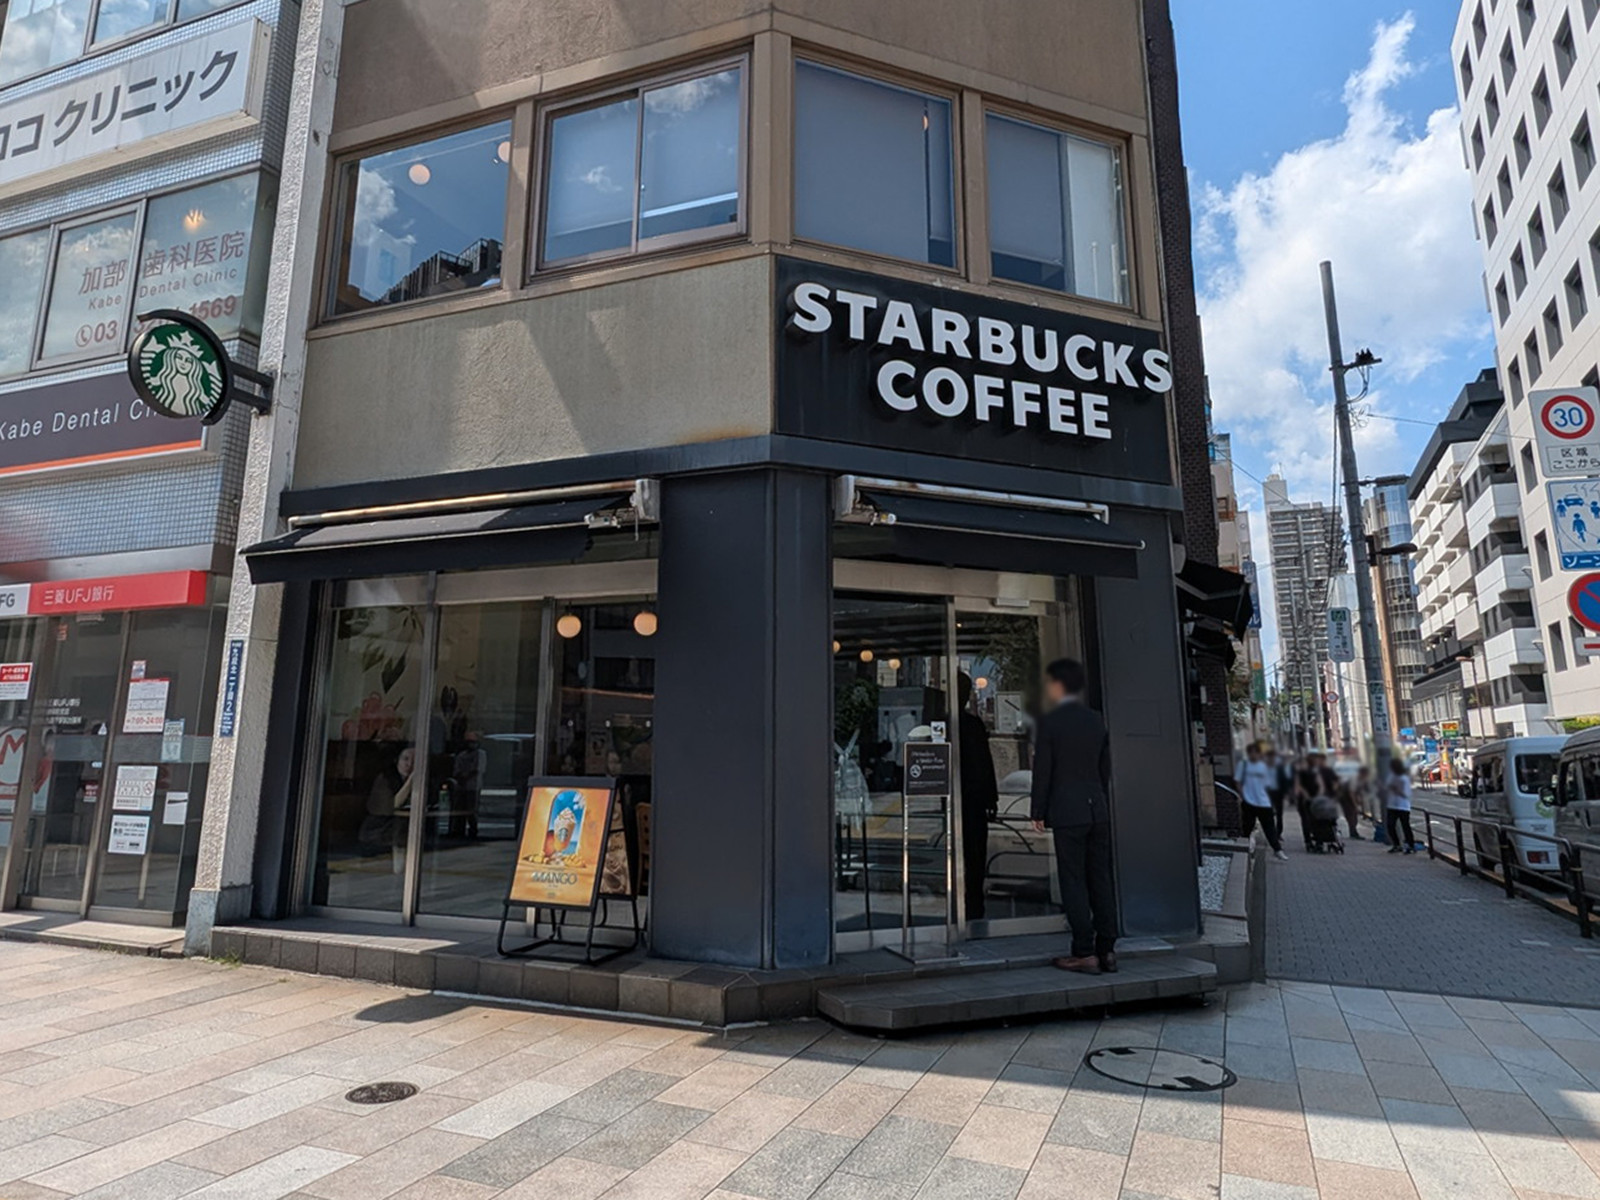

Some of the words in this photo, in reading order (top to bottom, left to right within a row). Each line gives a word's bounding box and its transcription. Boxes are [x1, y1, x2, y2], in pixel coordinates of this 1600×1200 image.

[78, 258, 128, 296] 加部
[142, 231, 246, 279] 歯科医院
[88, 294, 123, 311] Kabe
[137, 276, 187, 299] Dental
[193, 266, 238, 287] Clinic
[93, 320, 117, 343] 03
[792, 281, 1173, 394] STARBUCKS
[876, 359, 1112, 440] COFFEE
[51, 402, 120, 433] Dental
[1553, 406, 1585, 428] 30
[1552, 457, 1600, 470] ここから
[1560, 446, 1589, 458] 区域
[43, 585, 115, 606] 三菱UFJ銀行
